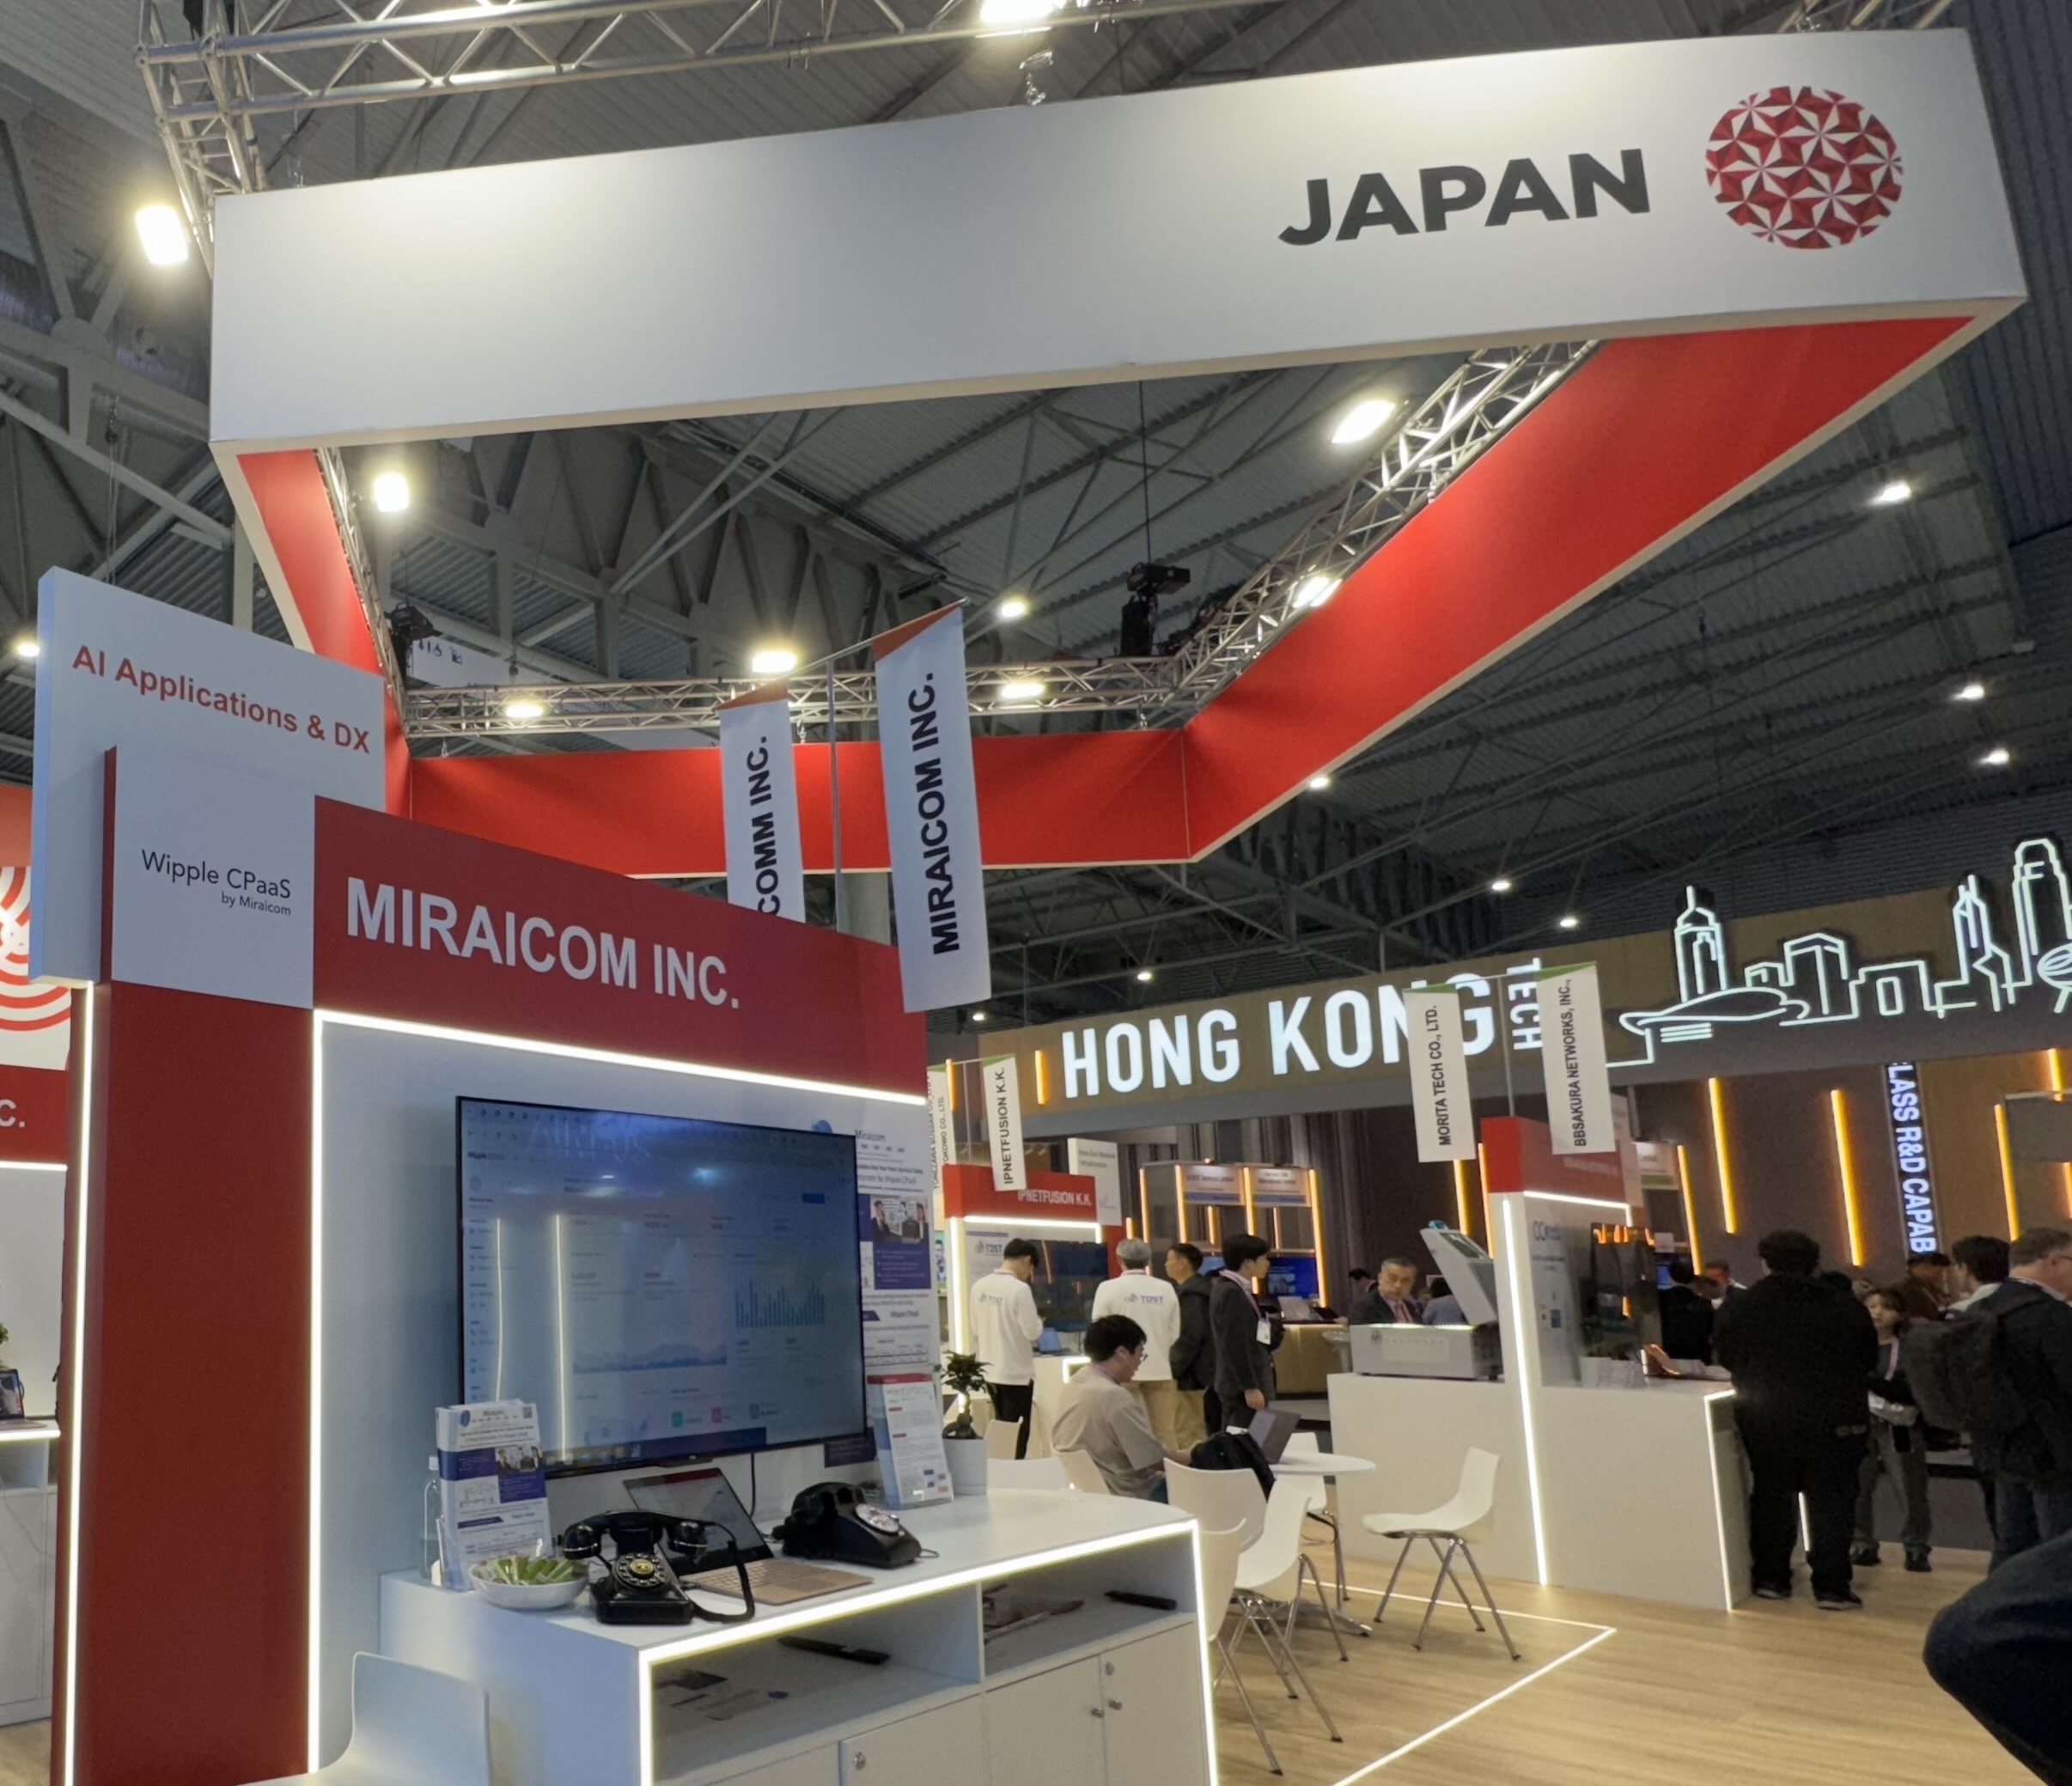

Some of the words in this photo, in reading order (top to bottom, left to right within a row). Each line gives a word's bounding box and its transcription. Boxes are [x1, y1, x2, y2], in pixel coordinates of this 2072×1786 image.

[1277, 148, 1650, 247] JAPAN
[72, 645, 105, 677] AI
[115, 658, 298, 733] Applications
[307, 715, 326, 741] &
[335, 722, 370, 754] DX
[909, 673, 939, 753] INC.
[747, 735, 772, 807] INC.
[142, 848, 219, 887] Wipple
[227, 868, 291, 899] CPaaS
[914, 758, 960, 955] MIRAICOM
[222, 891, 235, 908] by
[240, 895, 291, 916] Miraicom
[347, 876, 637, 990] MIRAICOM
[654, 943, 740, 1009] INC.
[1062, 1009, 1241, 1099] HONG
[1269, 972, 1496, 1076] KONG
[1425, 1004, 1439, 1032] LTD.
[1507, 957, 1543, 1051] TECH
[1428, 1034, 1442, 1060] CO.,
[1429, 1061, 1446, 1097] TECH
[1560, 1008, 1579, 1079] NETWORKS,
[995, 1067, 1006, 1094] K.K.
[1569, 1080, 1587, 1147] BBSAKURA
[1888, 1062, 1920, 1122] LASS
[996, 1097, 1015, 1185] IPNETFUSION
[1433, 1098, 1452, 1146] MORITA
[1896, 1126, 1926, 1173] R&D
[1902, 1177, 1936, 1253] CAPAB
